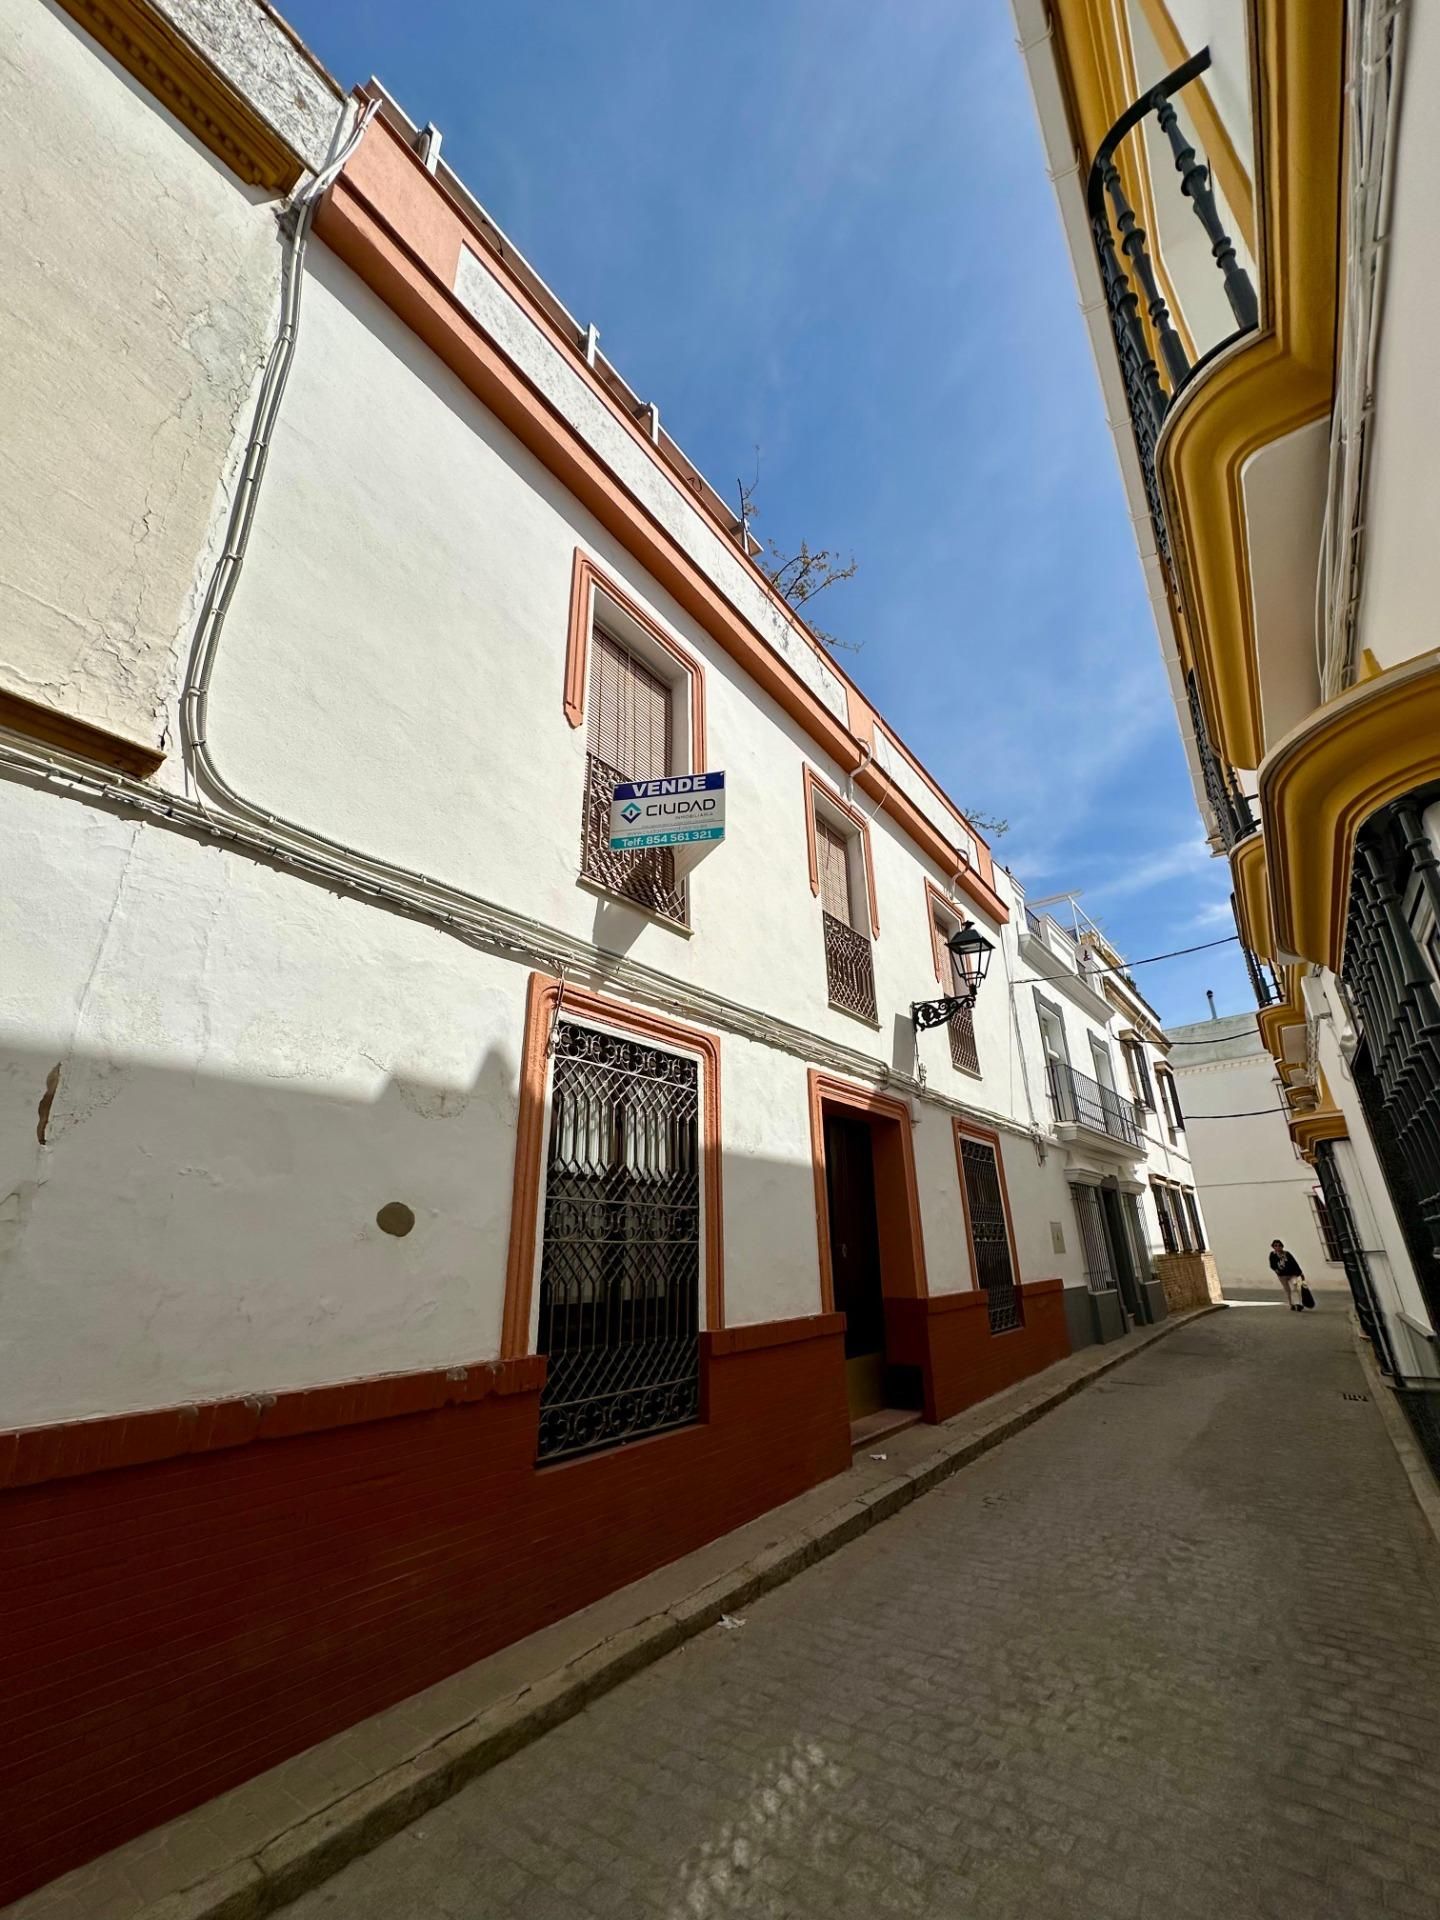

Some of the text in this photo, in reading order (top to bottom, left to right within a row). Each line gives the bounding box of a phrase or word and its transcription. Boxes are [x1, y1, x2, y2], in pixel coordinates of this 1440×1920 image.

[632, 776, 707, 797] VENDE
[646, 798, 716, 817] CIUDAD
[622, 838, 644, 847] Telf:
[646, 834, 668, 845] 854
[669, 832, 690, 842] 561
[692, 830, 712, 840] 321
